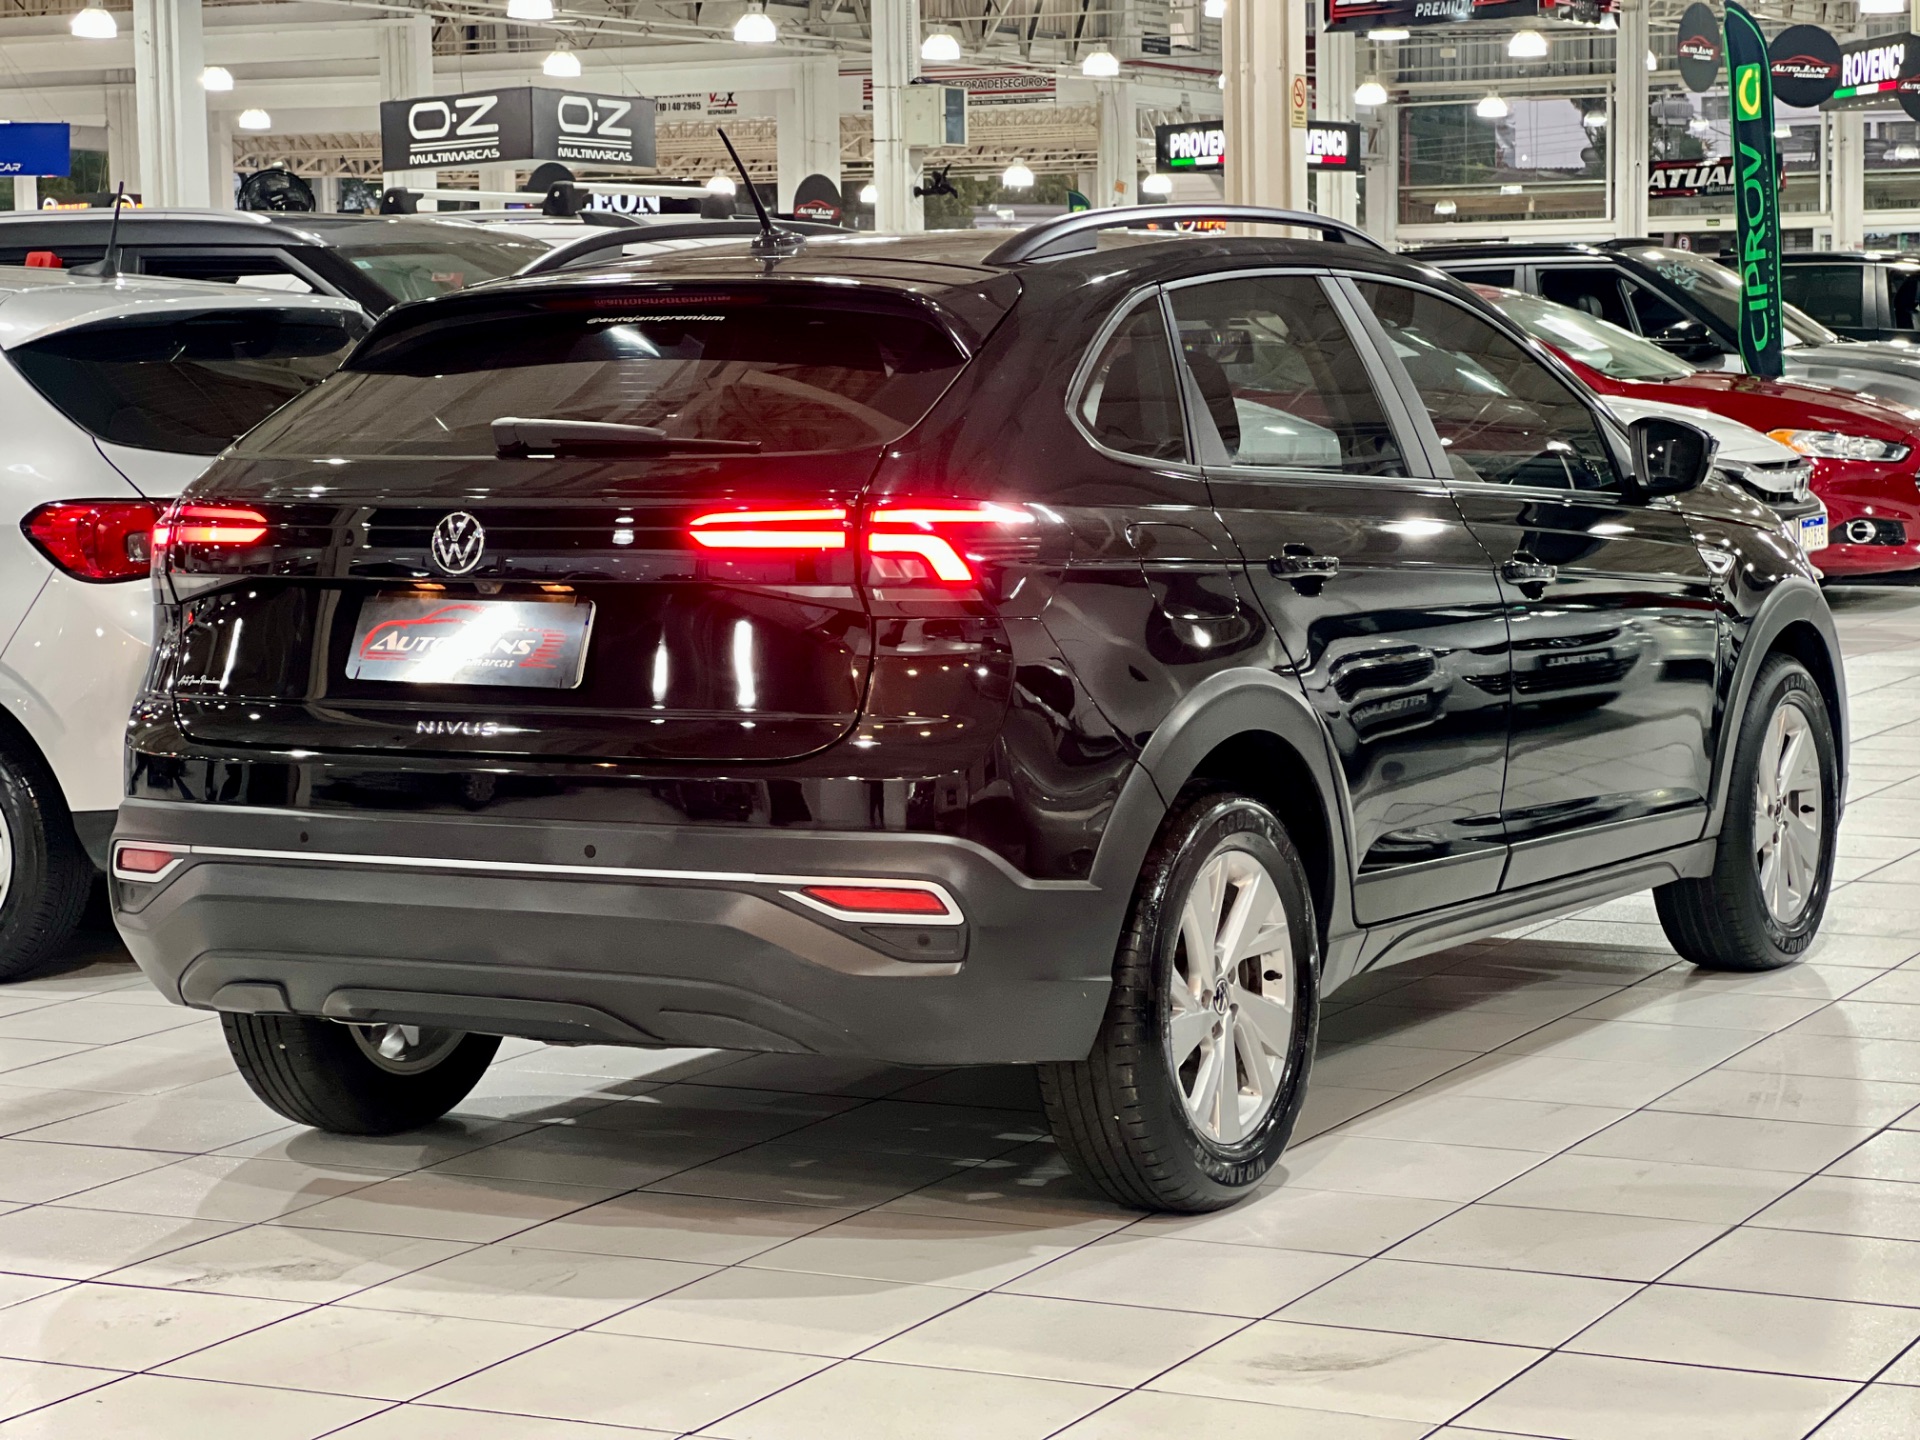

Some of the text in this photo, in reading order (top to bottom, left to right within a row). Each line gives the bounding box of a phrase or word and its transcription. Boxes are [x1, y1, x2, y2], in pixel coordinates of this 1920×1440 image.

[1003, 76, 1048, 88] SEGUROS
[409, 147, 500, 165] MULTIMARCAS
[557, 146, 633, 162] MULTIMARCAS
[582, 192, 661, 214] EON
[1740, 142, 1767, 351] CIPROV
[586, 314, 726, 324] @autojanspremium
[416, 721, 500, 736] NIVUS
